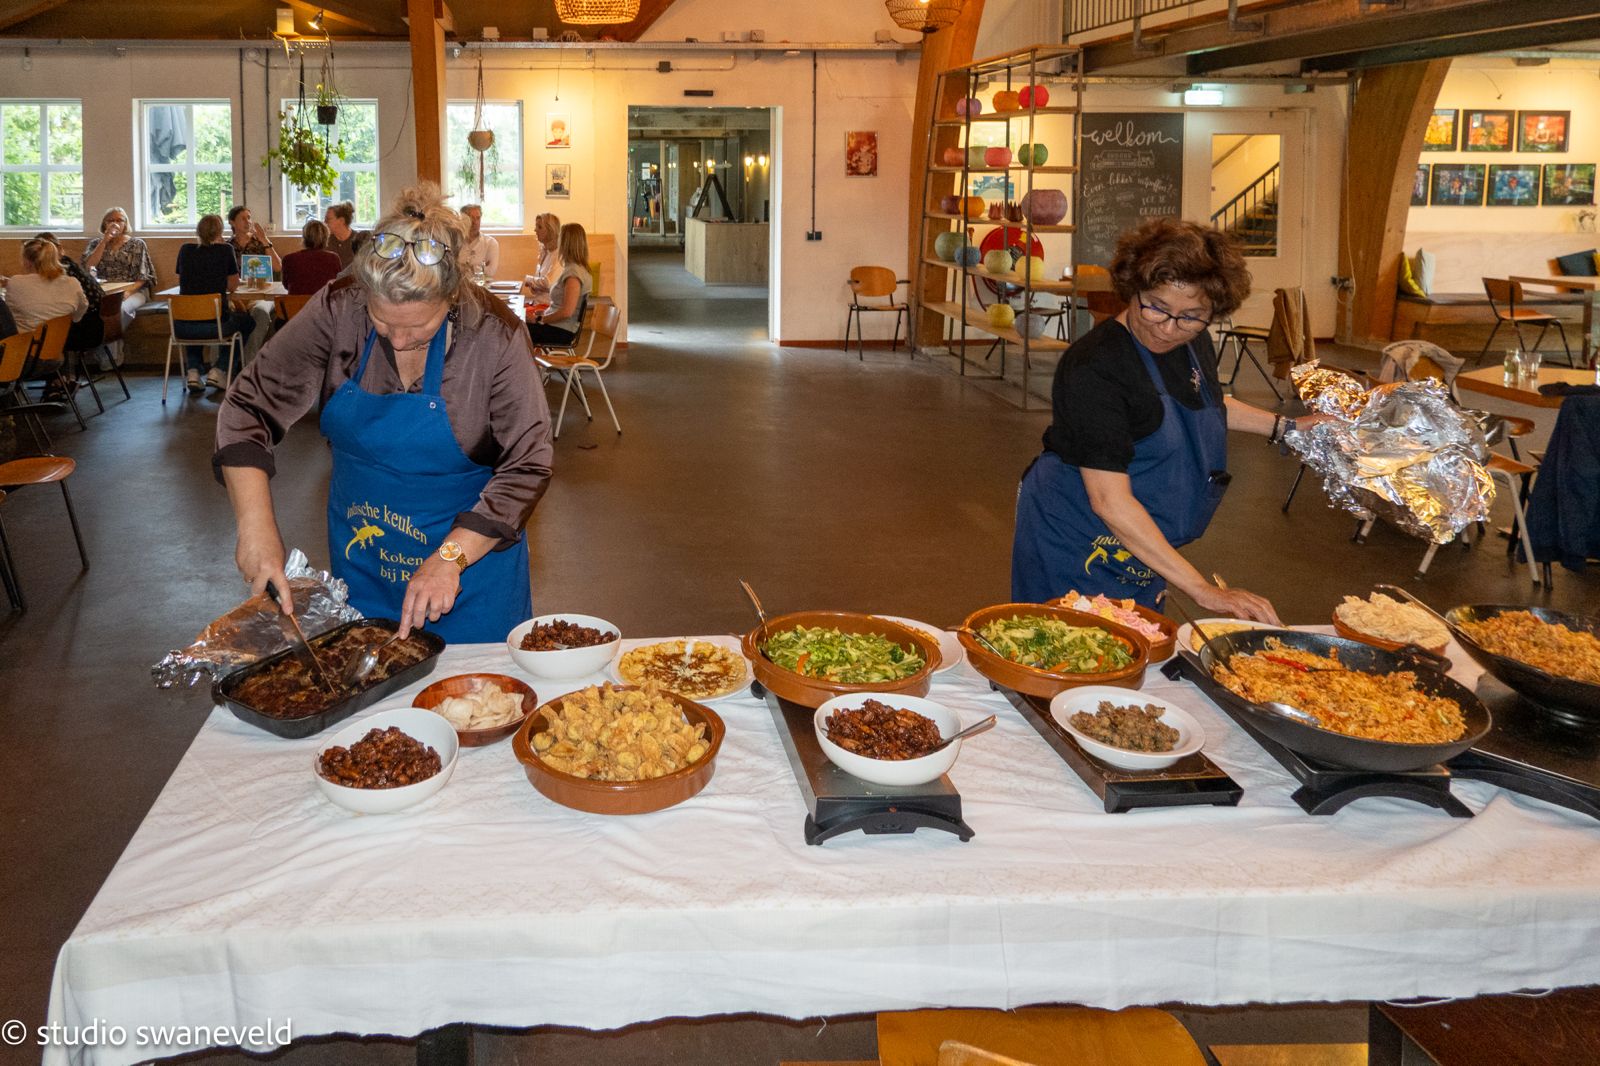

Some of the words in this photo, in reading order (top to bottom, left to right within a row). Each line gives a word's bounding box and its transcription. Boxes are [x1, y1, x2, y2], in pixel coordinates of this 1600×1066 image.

[1082, 120, 1179, 147] welkom
[384, 504, 428, 545] keuken
[380, 548, 424, 566] Koken
[380, 565, 397, 583] bij
